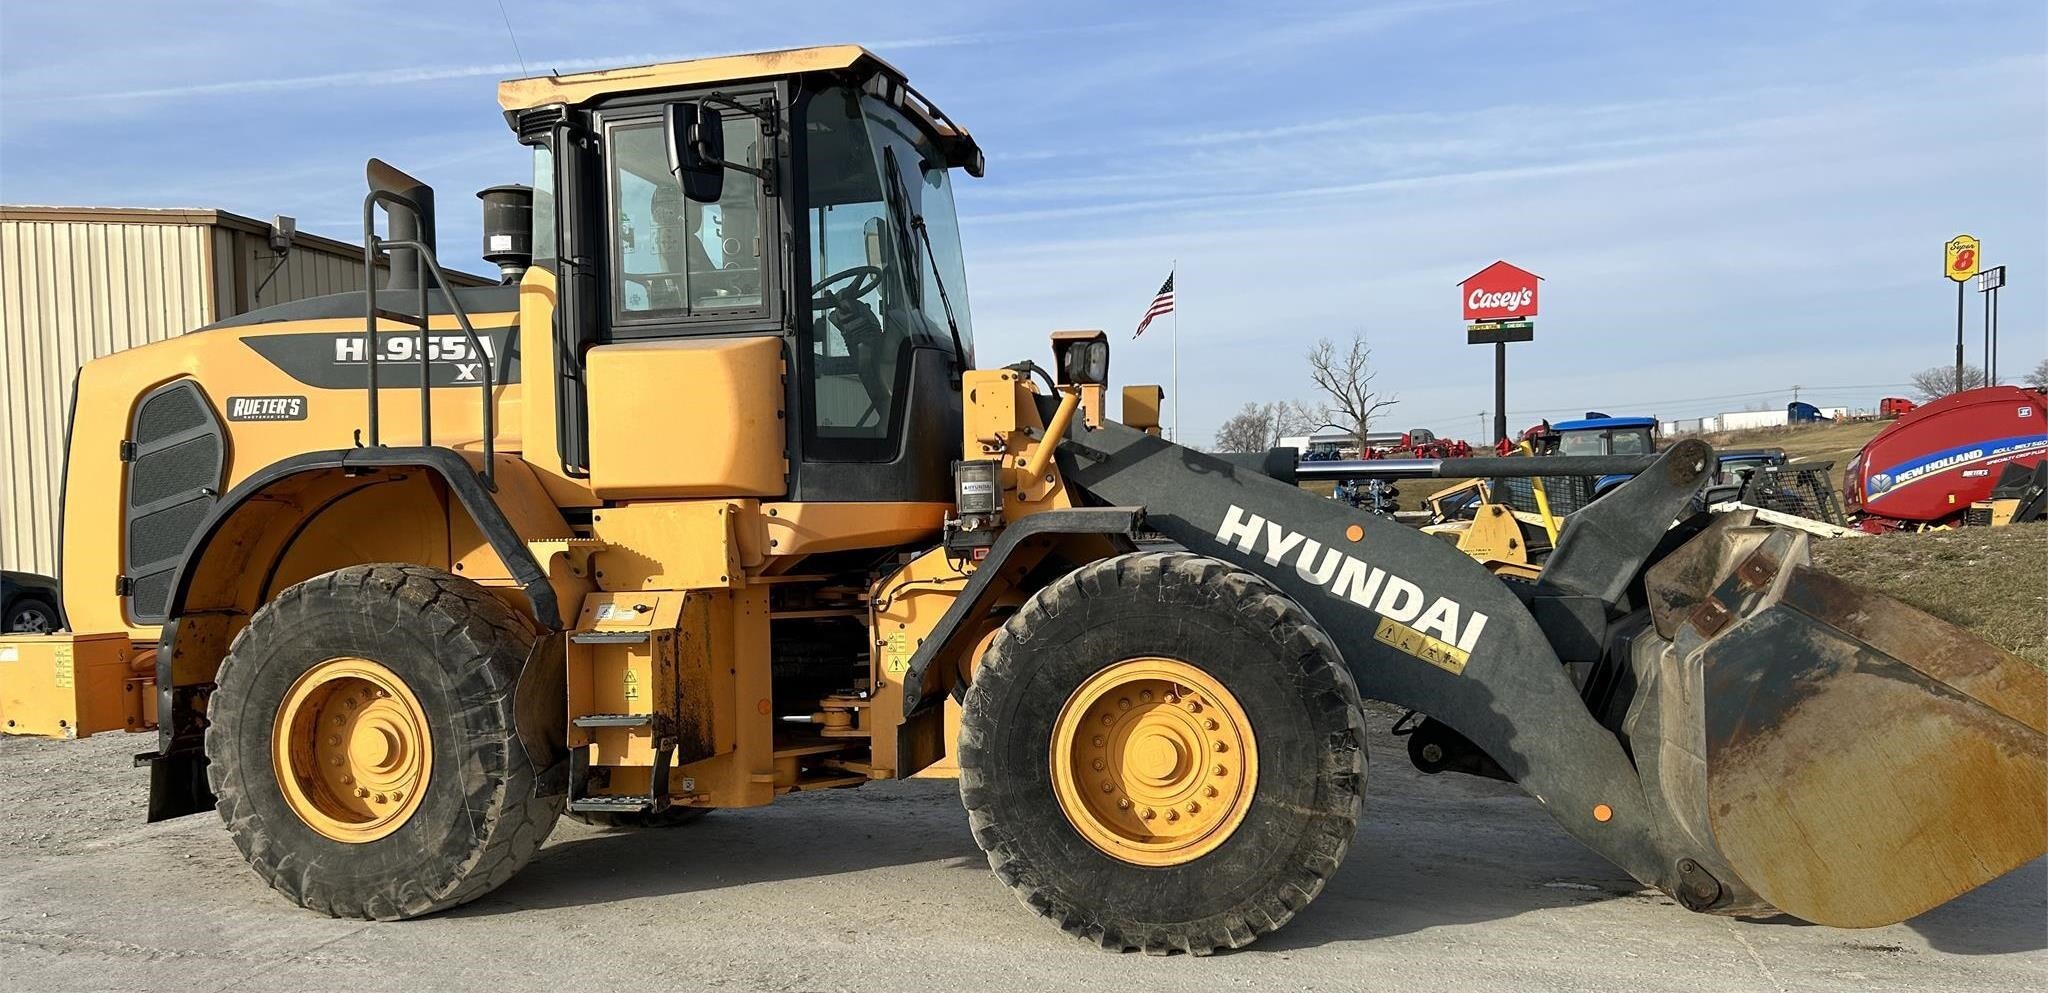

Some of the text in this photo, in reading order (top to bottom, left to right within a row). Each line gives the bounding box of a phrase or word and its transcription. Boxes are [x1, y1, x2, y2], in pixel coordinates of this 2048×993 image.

[1950, 241, 1975, 254] Super
[1952, 249, 1975, 271] 8
[1468, 287, 1533, 312] Casey's
[233, 398, 301, 417] RUETER'S
[1895, 449, 1983, 484] NEW HOLLAND
[1215, 504, 1488, 653] HYUNDAI
